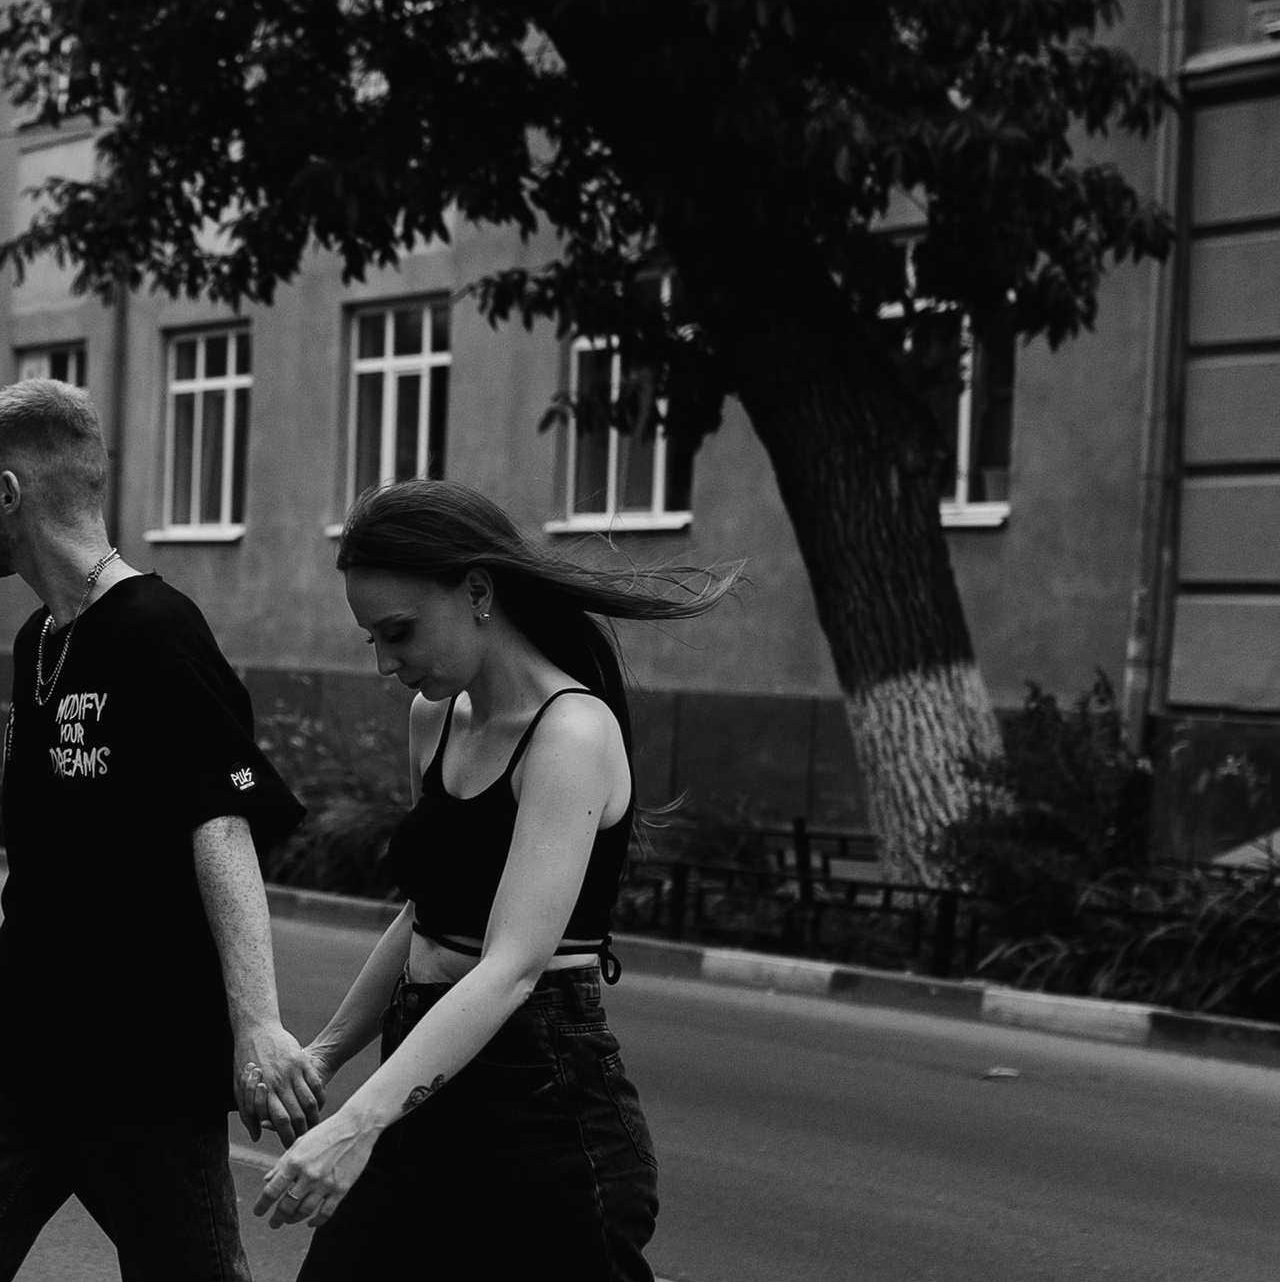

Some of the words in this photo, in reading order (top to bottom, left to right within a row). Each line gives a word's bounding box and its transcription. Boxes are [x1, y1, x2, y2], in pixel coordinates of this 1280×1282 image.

[55, 692, 108, 724] MODIFY
[60, 722, 85, 746] YOUR
[49, 746, 111, 779] DREAMS
